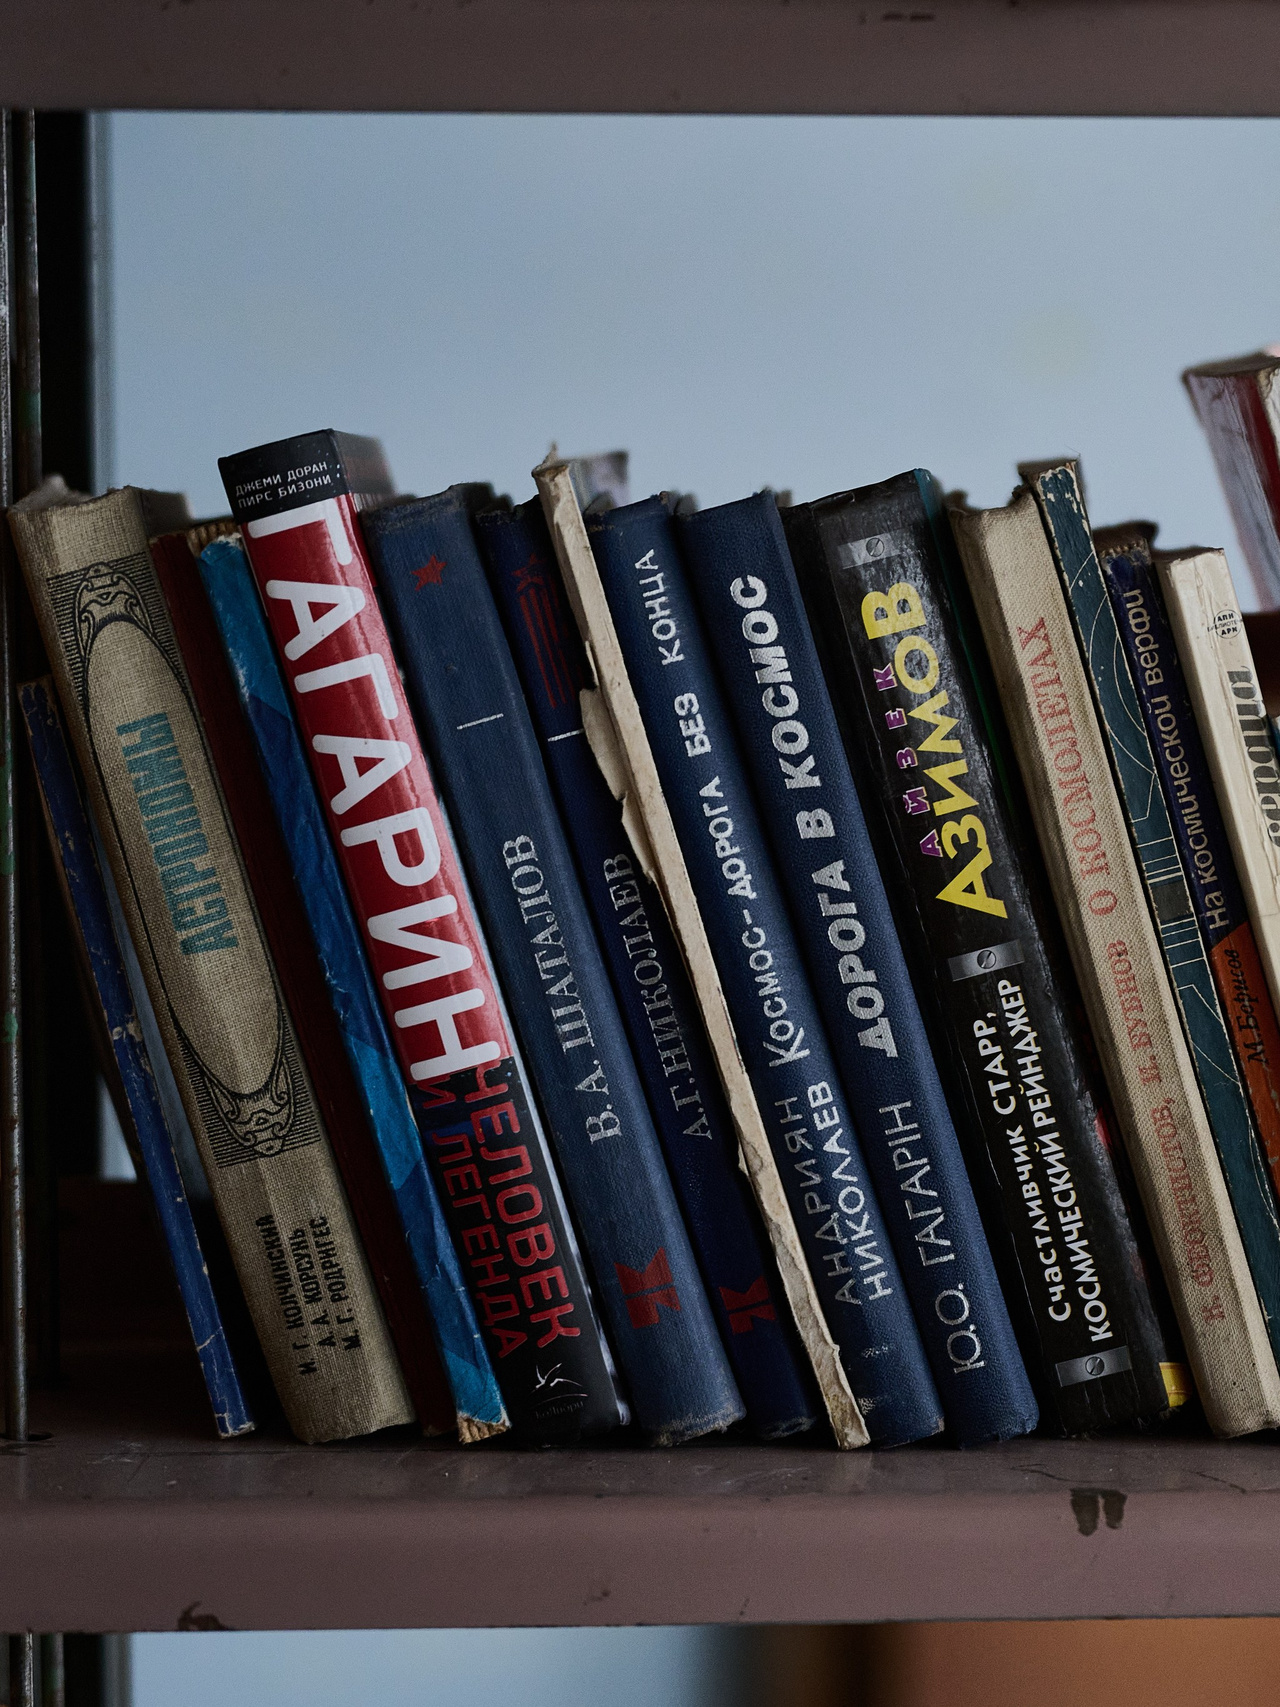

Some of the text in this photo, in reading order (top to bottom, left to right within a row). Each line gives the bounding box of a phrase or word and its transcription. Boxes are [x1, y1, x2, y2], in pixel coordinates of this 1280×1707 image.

[234, 460, 329, 498] ДЖЕМИ ДОРАН
[237, 473, 333, 509] ПИРС БИЗОНИ
[633, 548, 686, 667] КОНЦА
[246, 499, 502, 1083] ГАГАРИН
[673, 691, 713, 758] БЕЗ
[729, 572, 899, 1058] ДОРОГА В КОСМОС
[860, 581, 1010, 920] АЗИМОВ
[871, 662, 944, 858] АЙЗЕК
[1122, 587, 1232, 933] На космической верфи
[115, 711, 240, 956] АСТРОНОМЫ
[1086, 888, 1118, 918] О
[501, 833, 597, 1056] ШАТАЛОВ
[1105, 939, 1151, 1050] БУБНОВ
[972, 1010, 1018, 1117] СТАРР,
[414, 1074, 529, 1360] И ЛЕГЕНДА
[464, 1060, 582, 1350] ЧЕЛОВЕК
[773, 1095, 864, 1307] АНДРИЯН
[809, 1080, 895, 1302] НИКОЛАЕВ
[878, 1098, 957, 1269] ГАГАРІН
[997, 978, 1115, 1344] КОСМИЧЕСКИЙ РЕЙНДЖЕР
[1151, 1098, 1218, 1290] ФЕОКТИСТОВ,
[255, 1214, 305, 1330] КОЛЧИНСКИЙ
[288, 1227, 323, 1306] КОРСУНЬ
[308, 1216, 350, 1304] РОДРИГЕС
